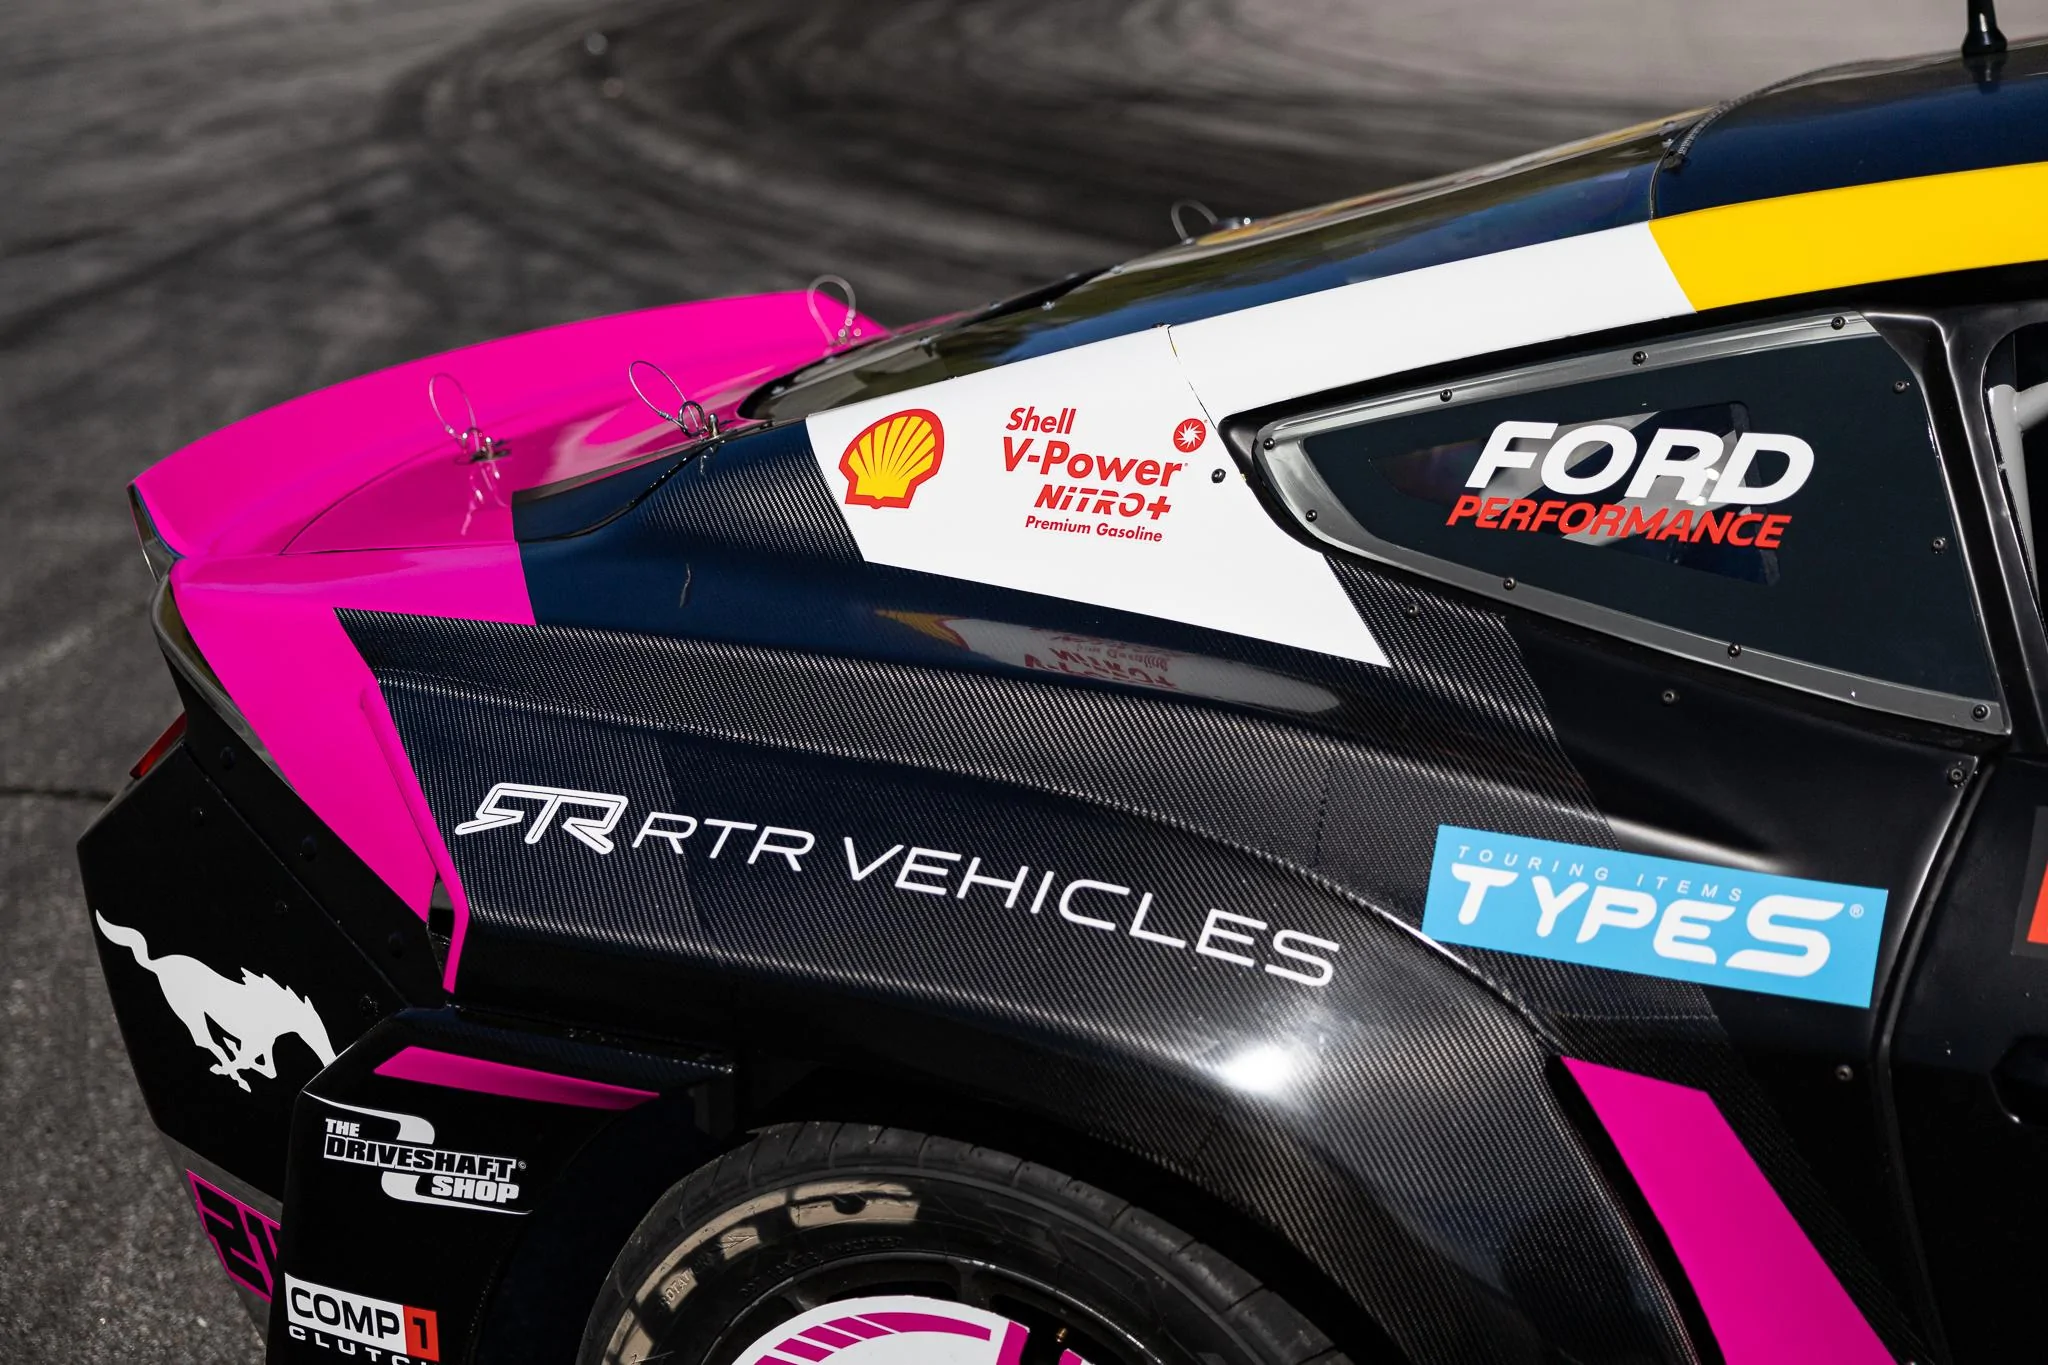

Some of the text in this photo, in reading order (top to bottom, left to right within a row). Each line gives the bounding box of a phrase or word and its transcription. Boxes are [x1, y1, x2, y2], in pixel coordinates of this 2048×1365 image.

[1006, 406, 1076, 434] Shell
[1003, 436, 1182, 487] V-Power
[1465, 420, 1815, 505] FORD
[1025, 515, 1163, 542] Premium Gasoline
[1445, 494, 1792, 549] PERFORMANCE
[1457, 845, 1742, 902] TOURING ITEMS
[632, 811, 815, 872] RTR
[843, 836, 1340, 987] VEHICLES
[325, 1118, 360, 1137] THE
[431, 1175, 519, 1203] SHOP
[289, 1325, 428, 1365] CLUTC
